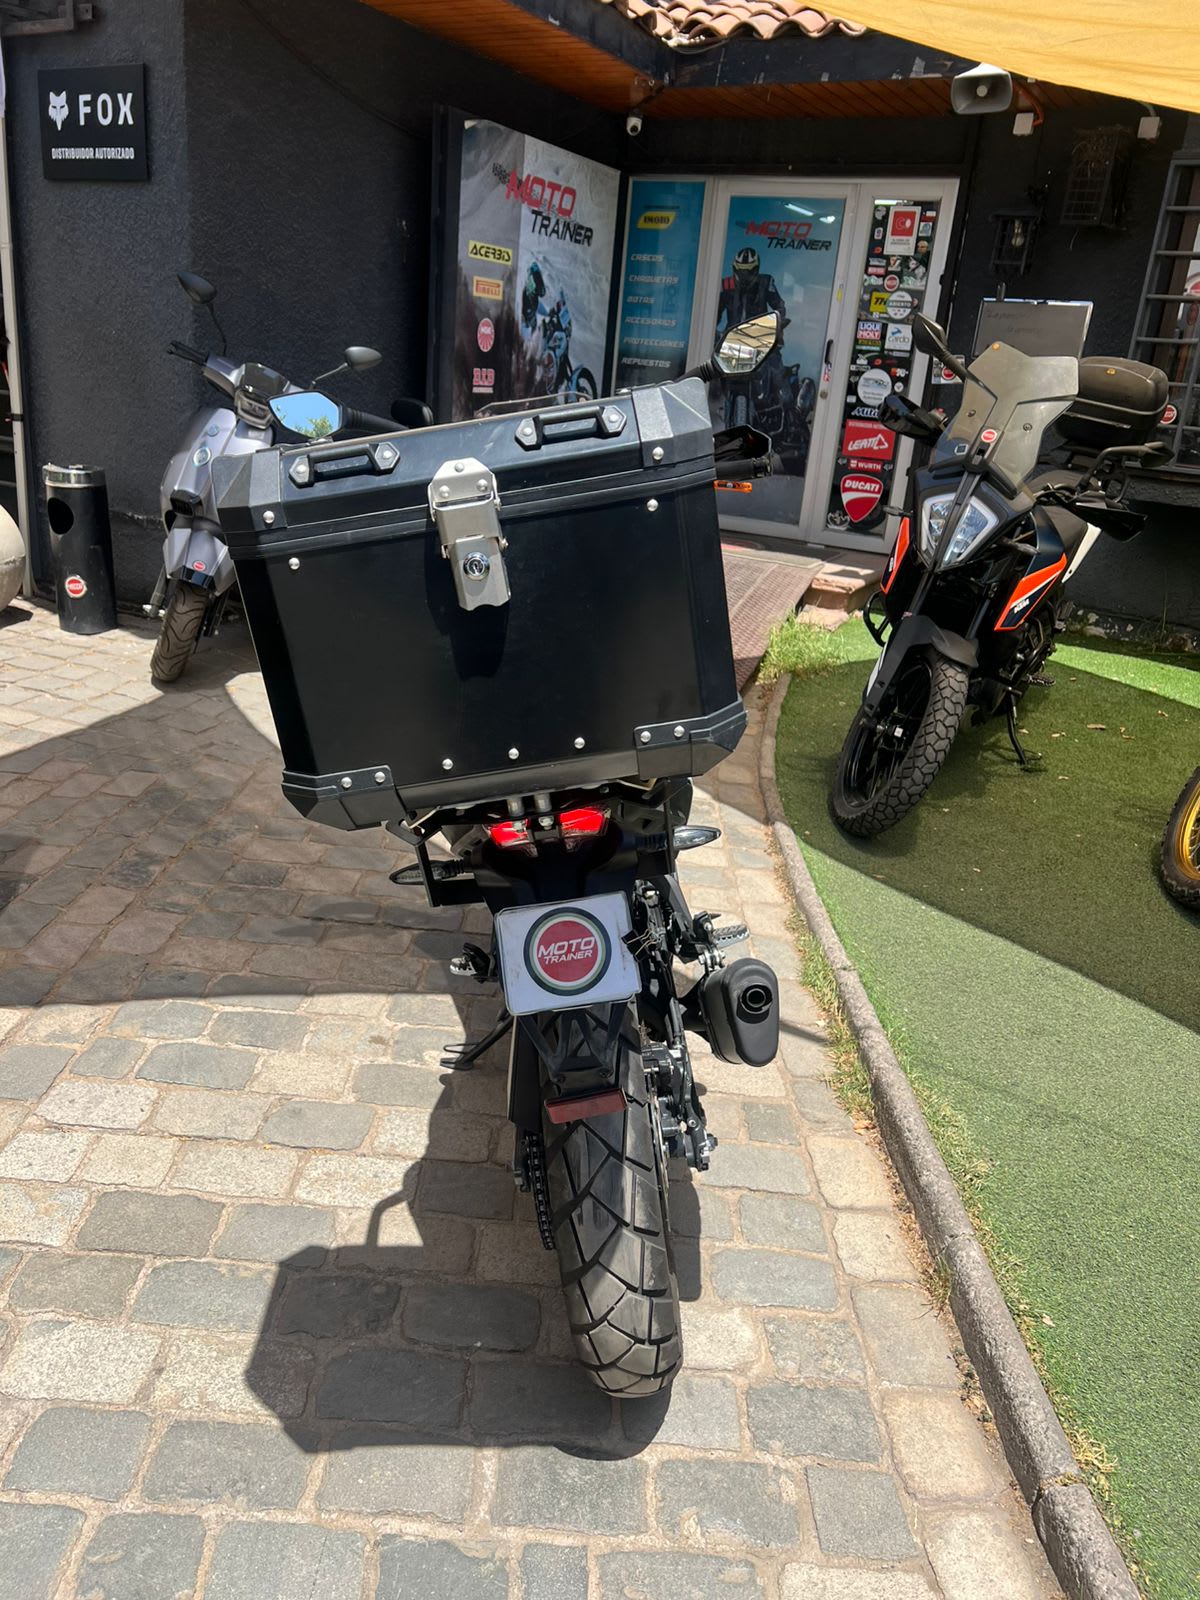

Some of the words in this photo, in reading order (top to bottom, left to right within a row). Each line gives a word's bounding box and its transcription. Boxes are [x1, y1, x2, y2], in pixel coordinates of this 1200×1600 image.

[79, 92, 134, 126] FOX
[52, 147, 94, 159] DISTRIBUIDOR
[95, 147, 134, 160] AUTORIZADO
[505, 169, 577, 217] MOTO
[531, 209, 594, 247] TRAINER
[744, 220, 813, 240] MOTO
[767, 237, 832, 251] TRAINER
[469, 243, 511, 263] ACERBIS
[630, 253, 664, 262] CASCOS
[628, 275, 679, 285] CHAQUETAS
[626, 295, 656, 304] BOTAS
[623, 337, 685, 349] PROTECCIONES
[620, 357, 672, 368] REPUESTOS
[844, 480, 880, 493] DUCATI
[538, 936, 596, 958] MOTO
[544, 949, 593, 965] TRAINER
